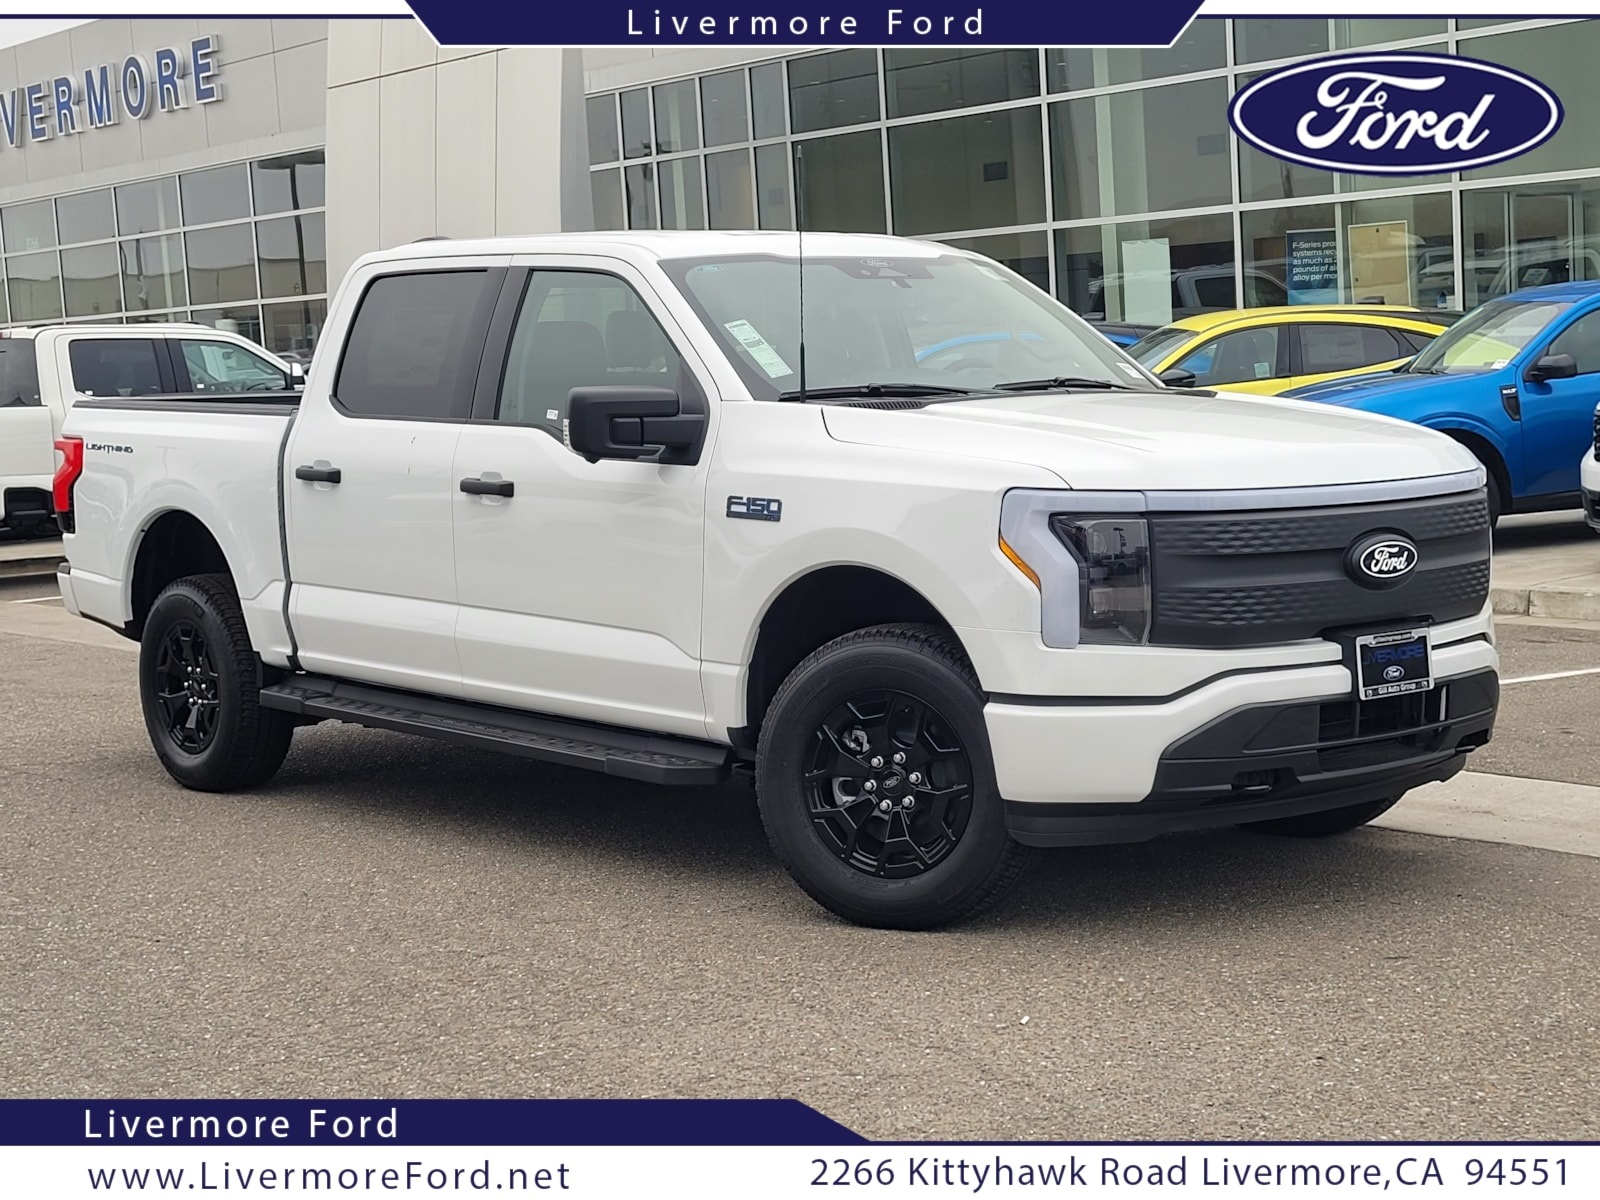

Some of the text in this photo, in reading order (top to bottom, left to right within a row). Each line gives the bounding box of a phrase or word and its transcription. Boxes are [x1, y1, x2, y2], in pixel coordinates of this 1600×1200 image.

[0, 34, 223, 148] VERMORE
[1292, 241, 1321, 249] F-Series
[1293, 265, 1320, 274] pounds
[1320, 264, 1329, 272] of
[1371, 546, 1408, 573] Ford
